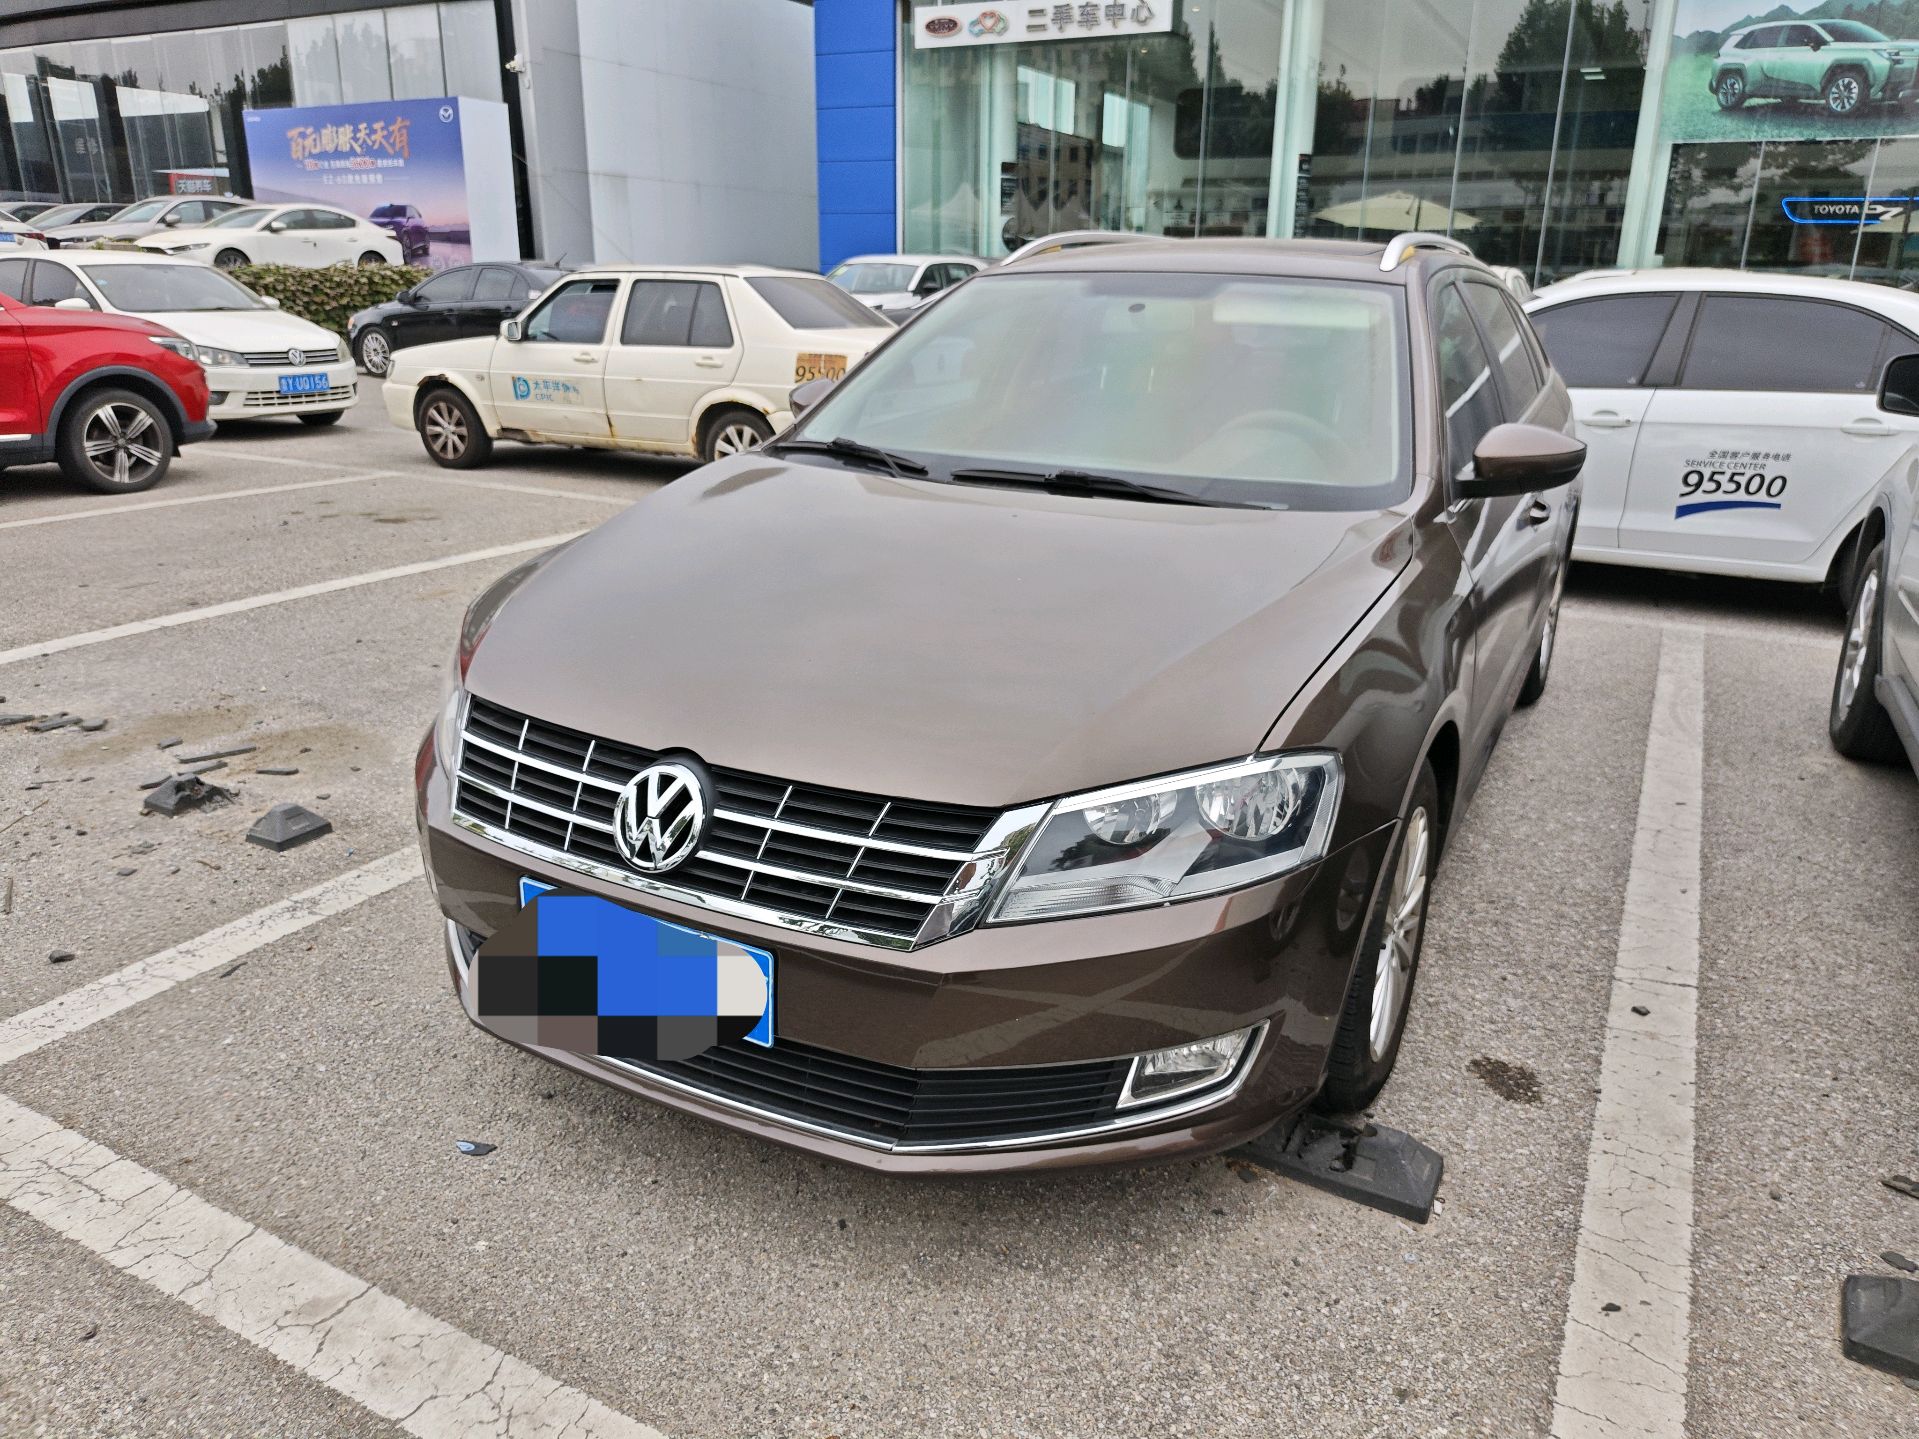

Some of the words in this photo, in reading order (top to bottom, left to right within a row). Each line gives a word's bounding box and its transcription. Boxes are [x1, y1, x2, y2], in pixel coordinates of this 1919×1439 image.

[1026, 0, 1155, 33] 二手车中心
[1813, 204, 1860, 215] TOYOTA
[1684, 459, 1726, 471] SERVICE
[1727, 461, 1767, 472] CENTER
[1679, 469, 1787, 499] 95500
